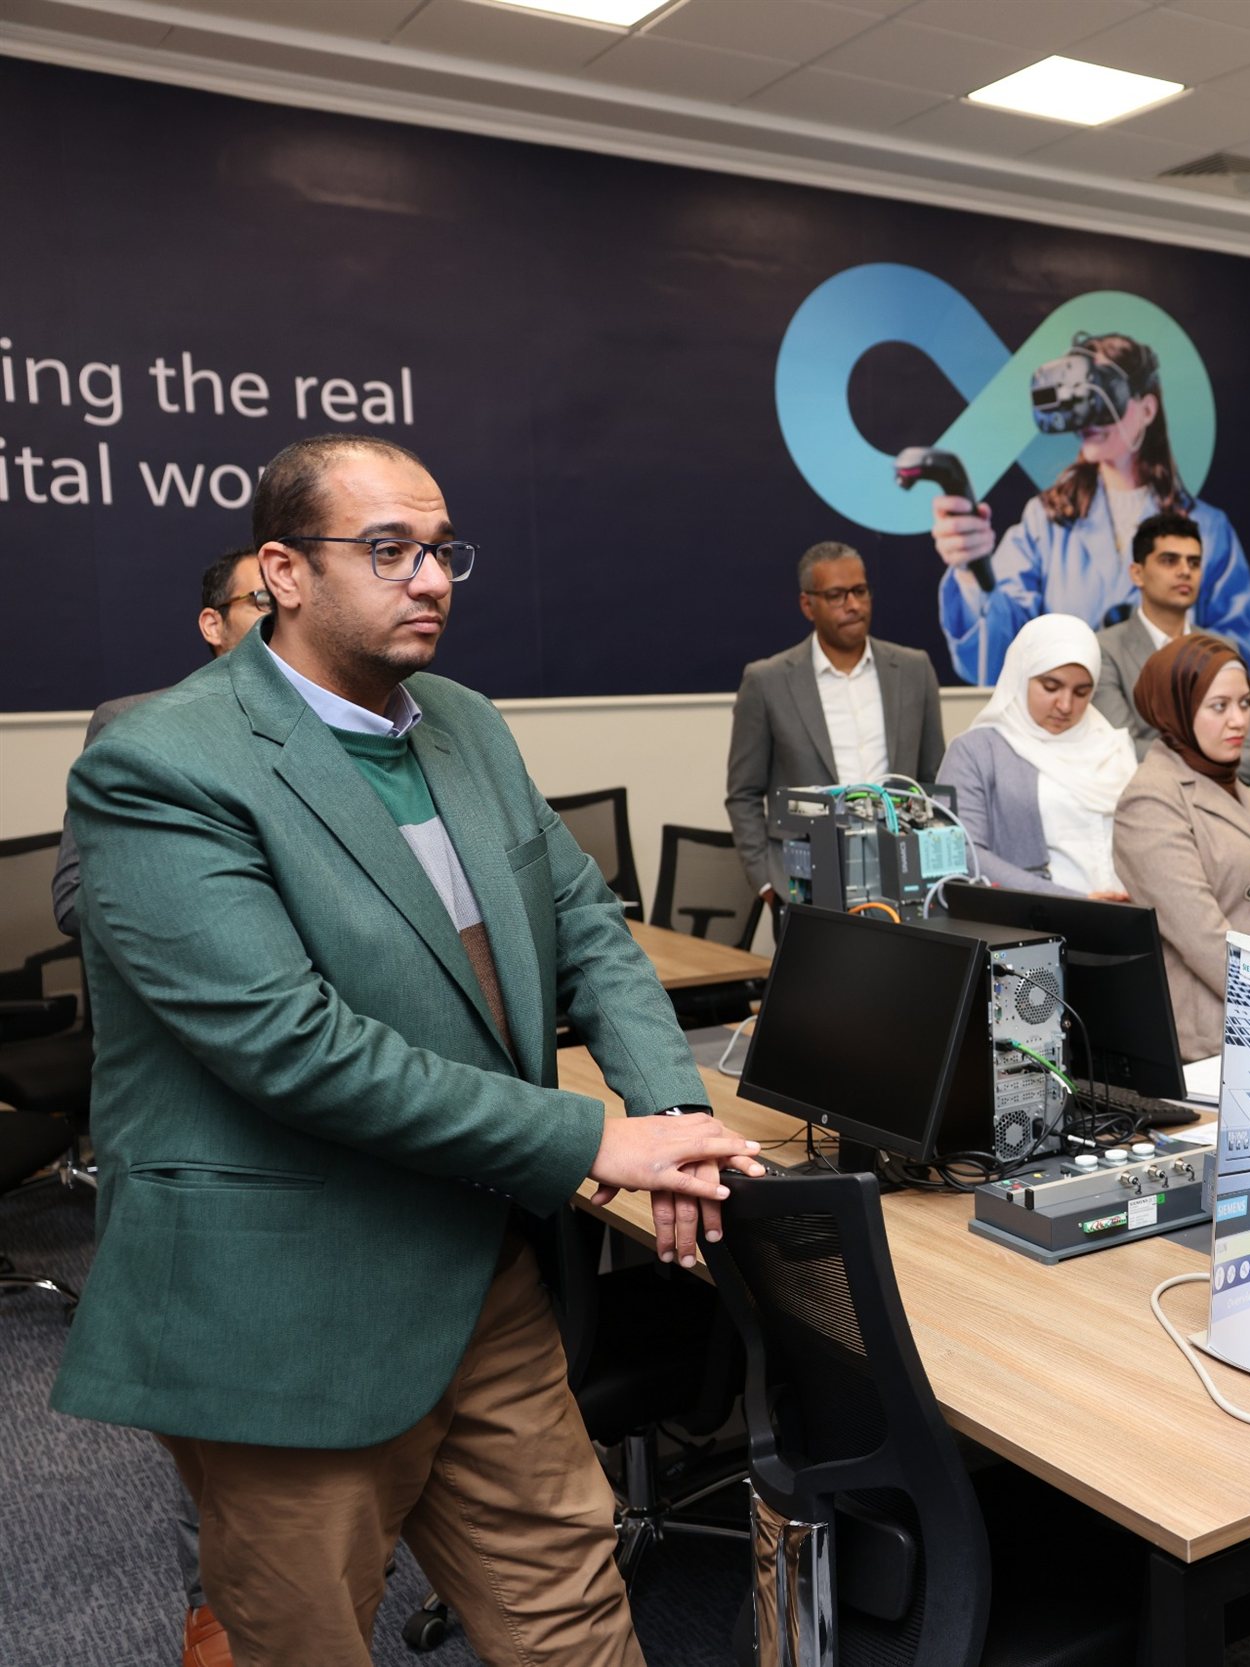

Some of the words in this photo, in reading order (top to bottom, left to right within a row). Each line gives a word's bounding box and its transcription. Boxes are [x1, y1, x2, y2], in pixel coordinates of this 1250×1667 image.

[0, 337, 124, 427] ing
[149, 351, 271, 419] the
[294, 366, 415, 426] real
[139, 462, 266, 511] wo
[1216, 1200, 1247, 1217] SIEMENS
